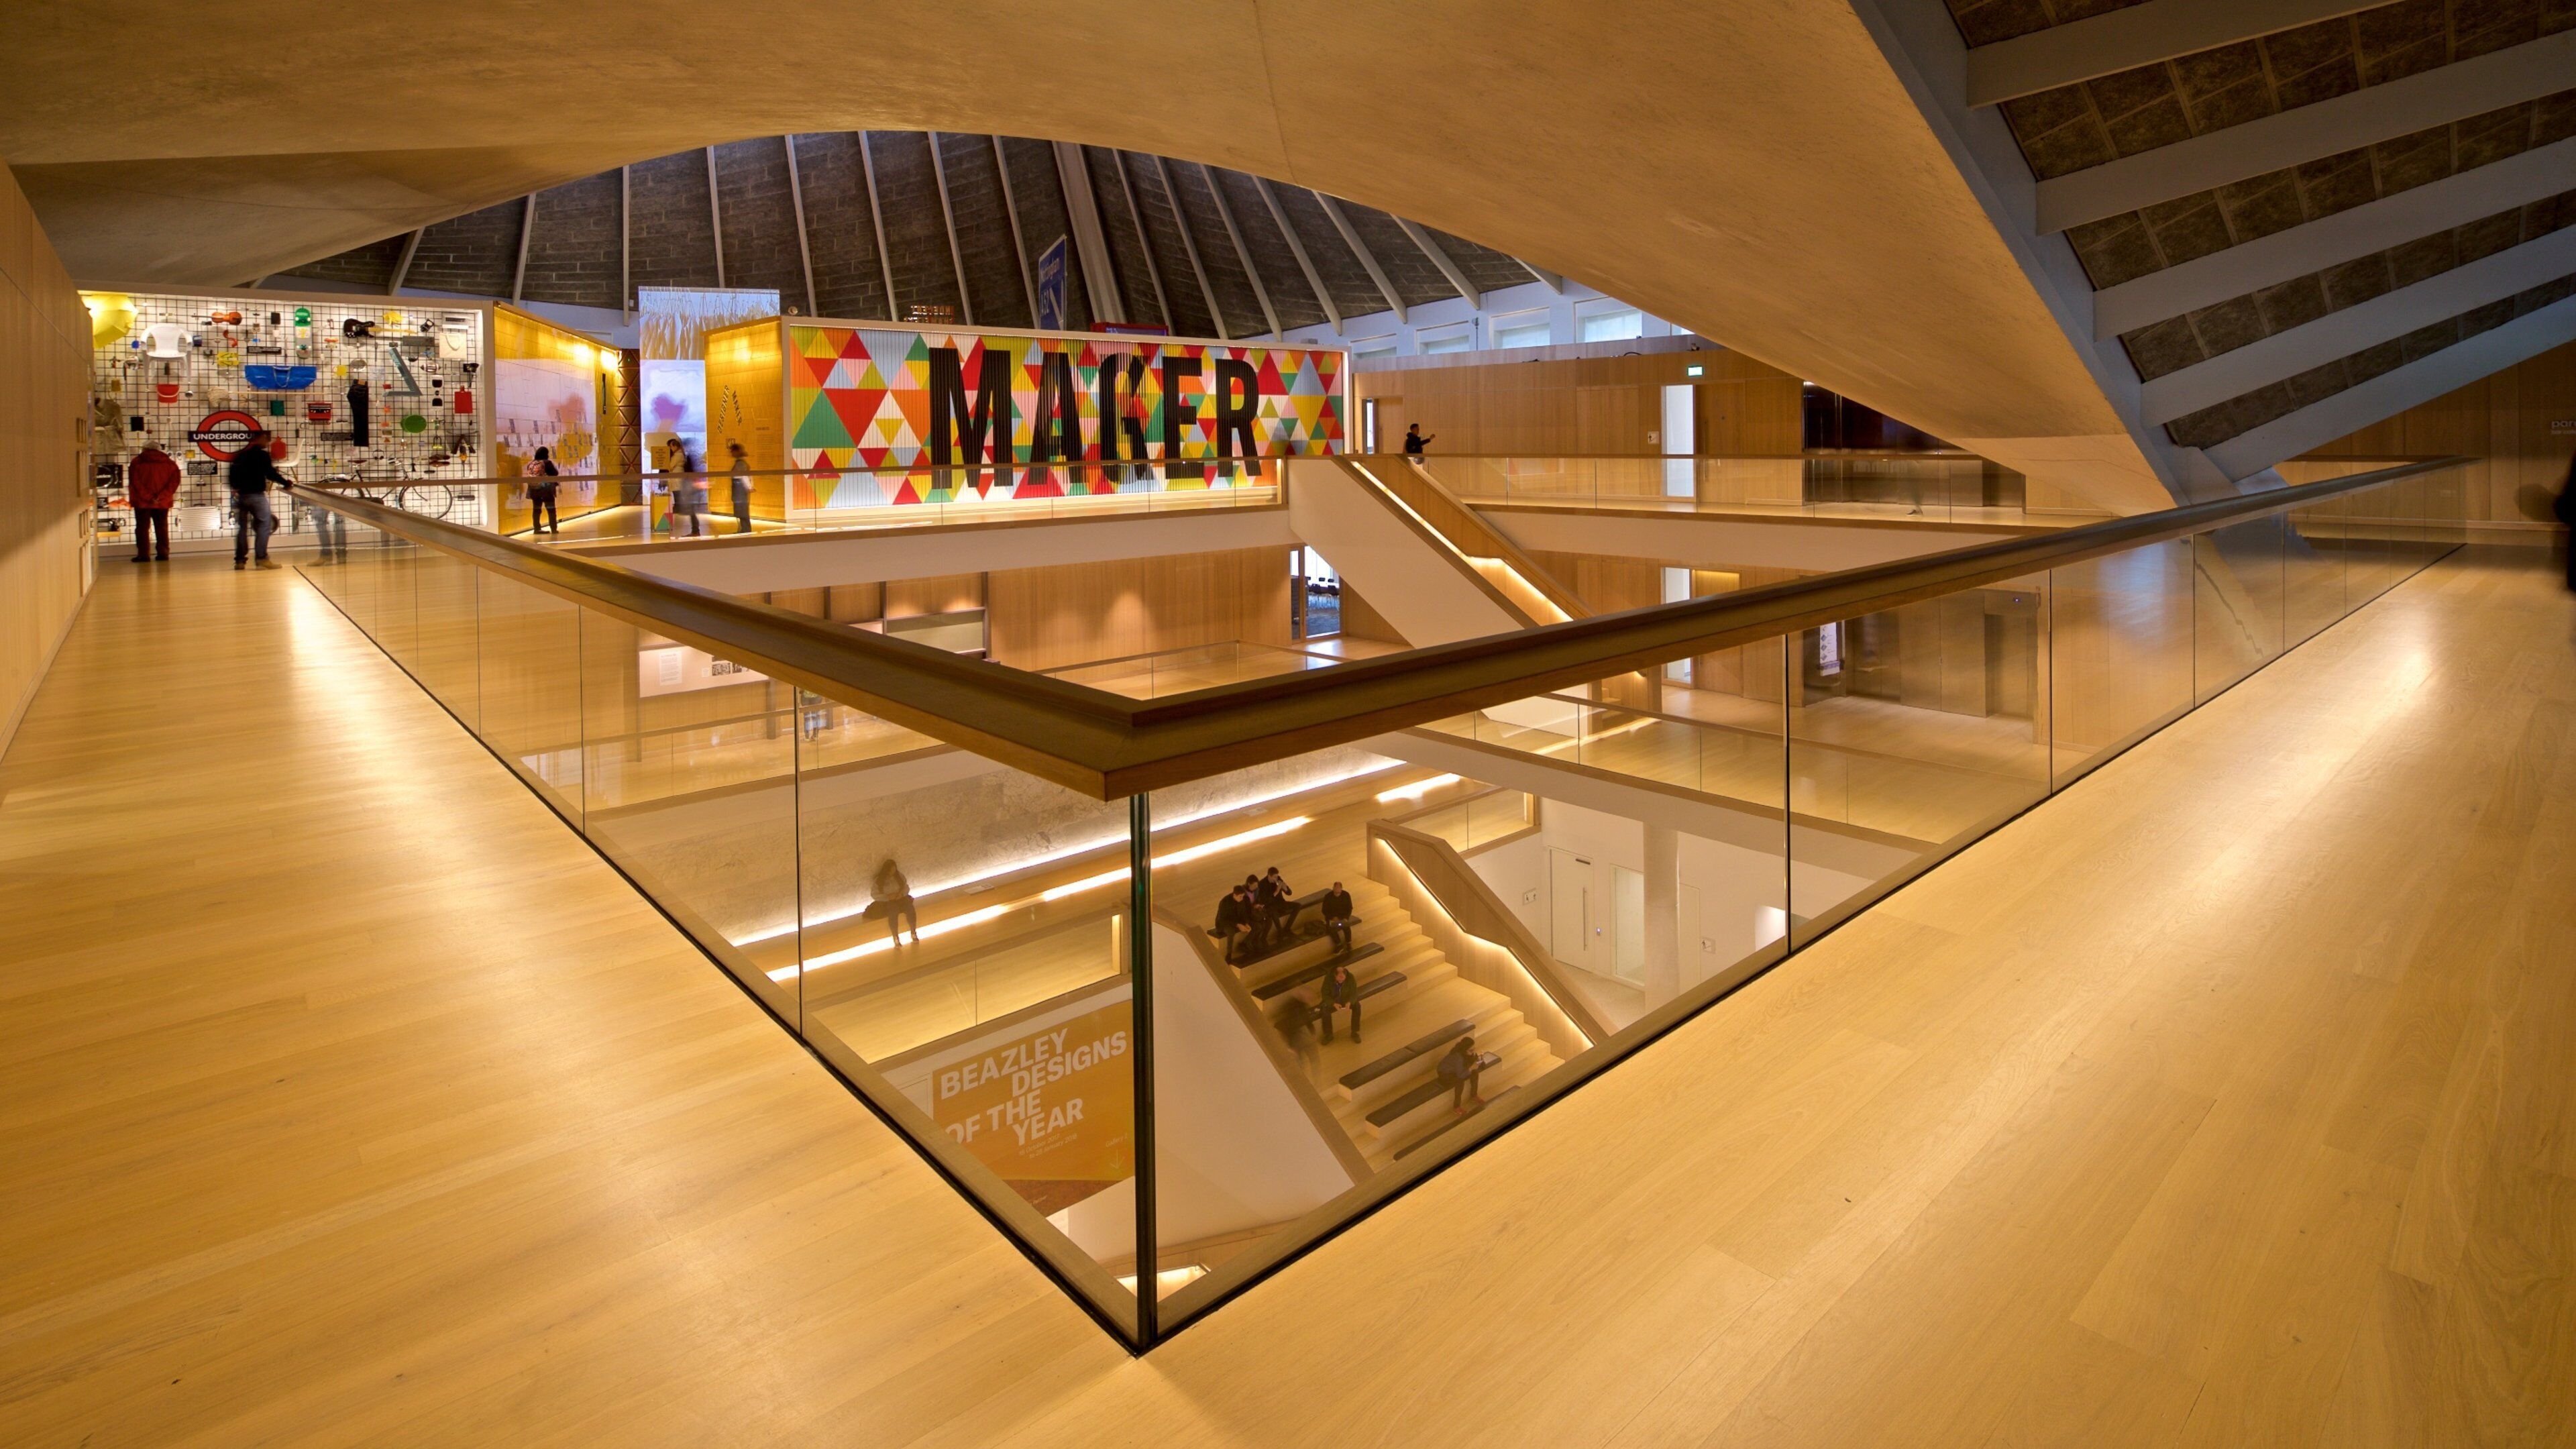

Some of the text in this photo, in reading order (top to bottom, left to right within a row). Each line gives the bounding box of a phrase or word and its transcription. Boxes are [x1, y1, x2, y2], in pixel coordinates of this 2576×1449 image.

[941, 1028, 1068, 1099] BEAZLEY
[1012, 1031, 1127, 1097] DESIGNS
[945, 1089, 1041, 1144] OF THE
[1012, 1098, 1084, 1146] YEAR
